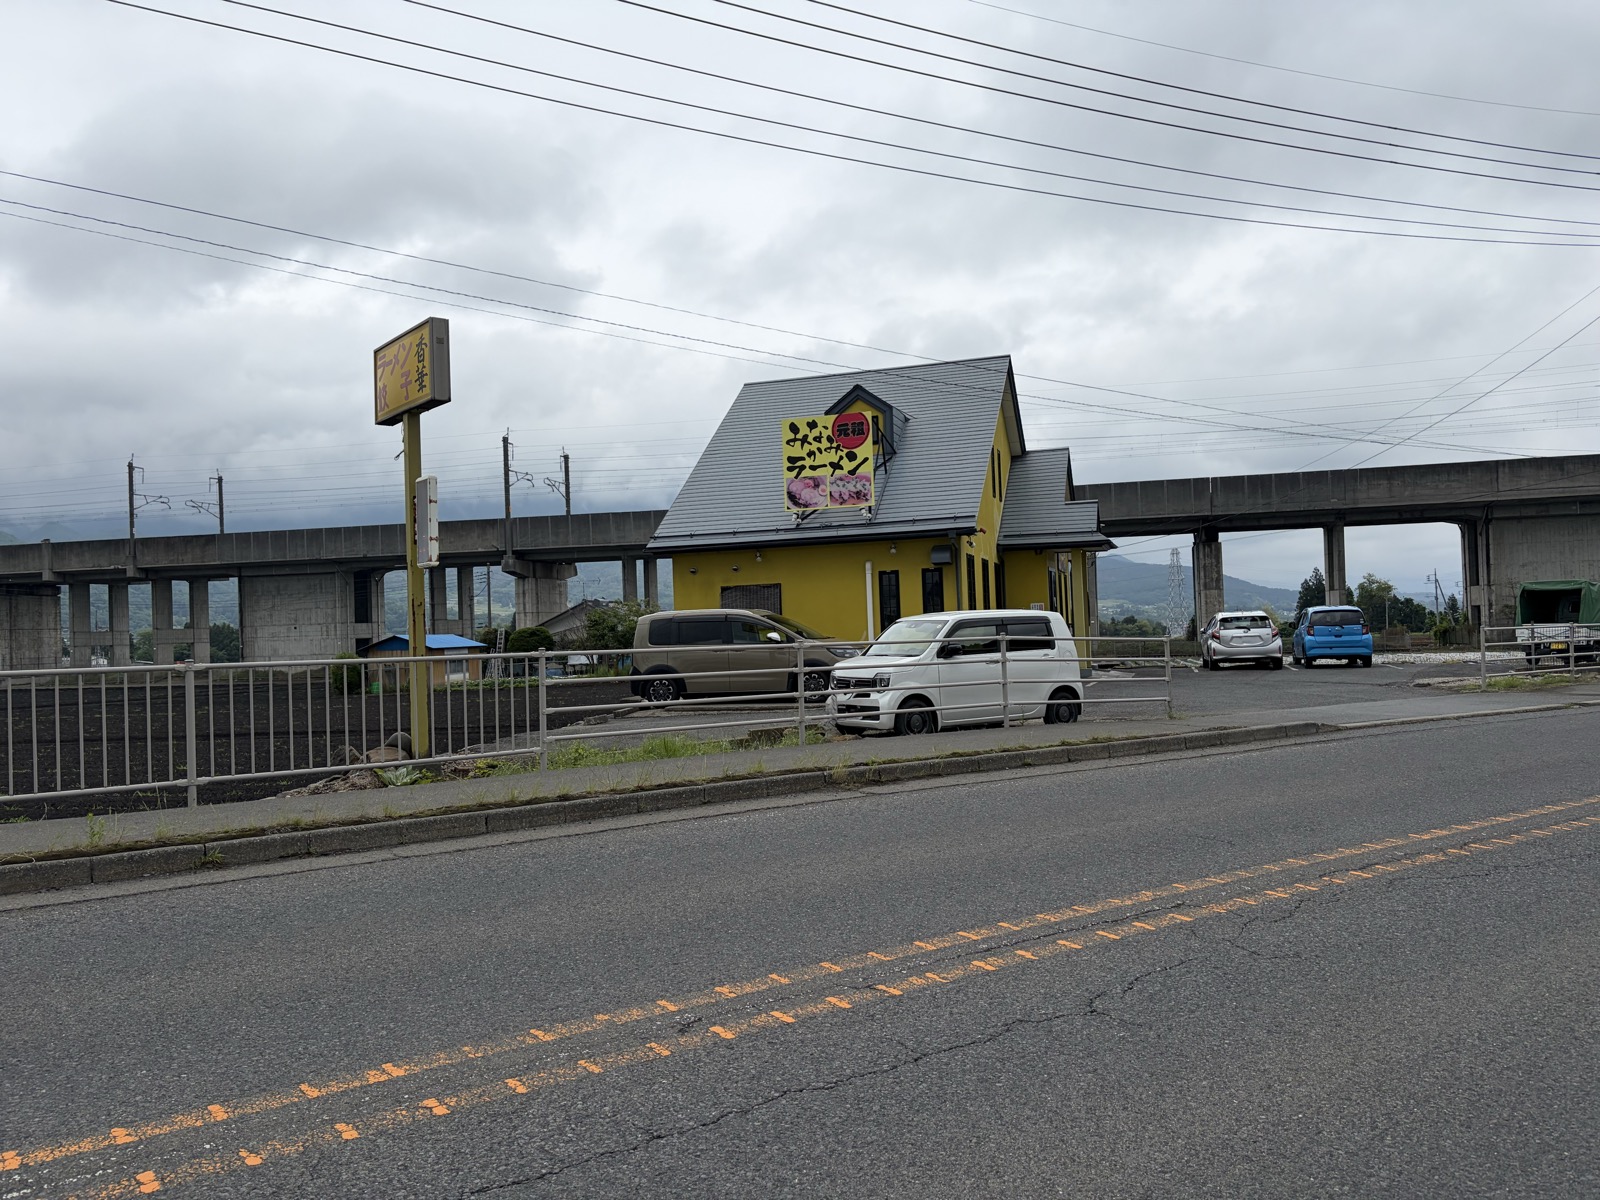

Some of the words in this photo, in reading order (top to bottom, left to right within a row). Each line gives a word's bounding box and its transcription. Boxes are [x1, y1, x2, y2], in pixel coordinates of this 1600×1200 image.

[377, 340, 413, 383] ラーメン
[786, 419, 844, 463] みなかみ
[836, 421, 866, 438] 元祖
[786, 450, 870, 480] ラーメン
